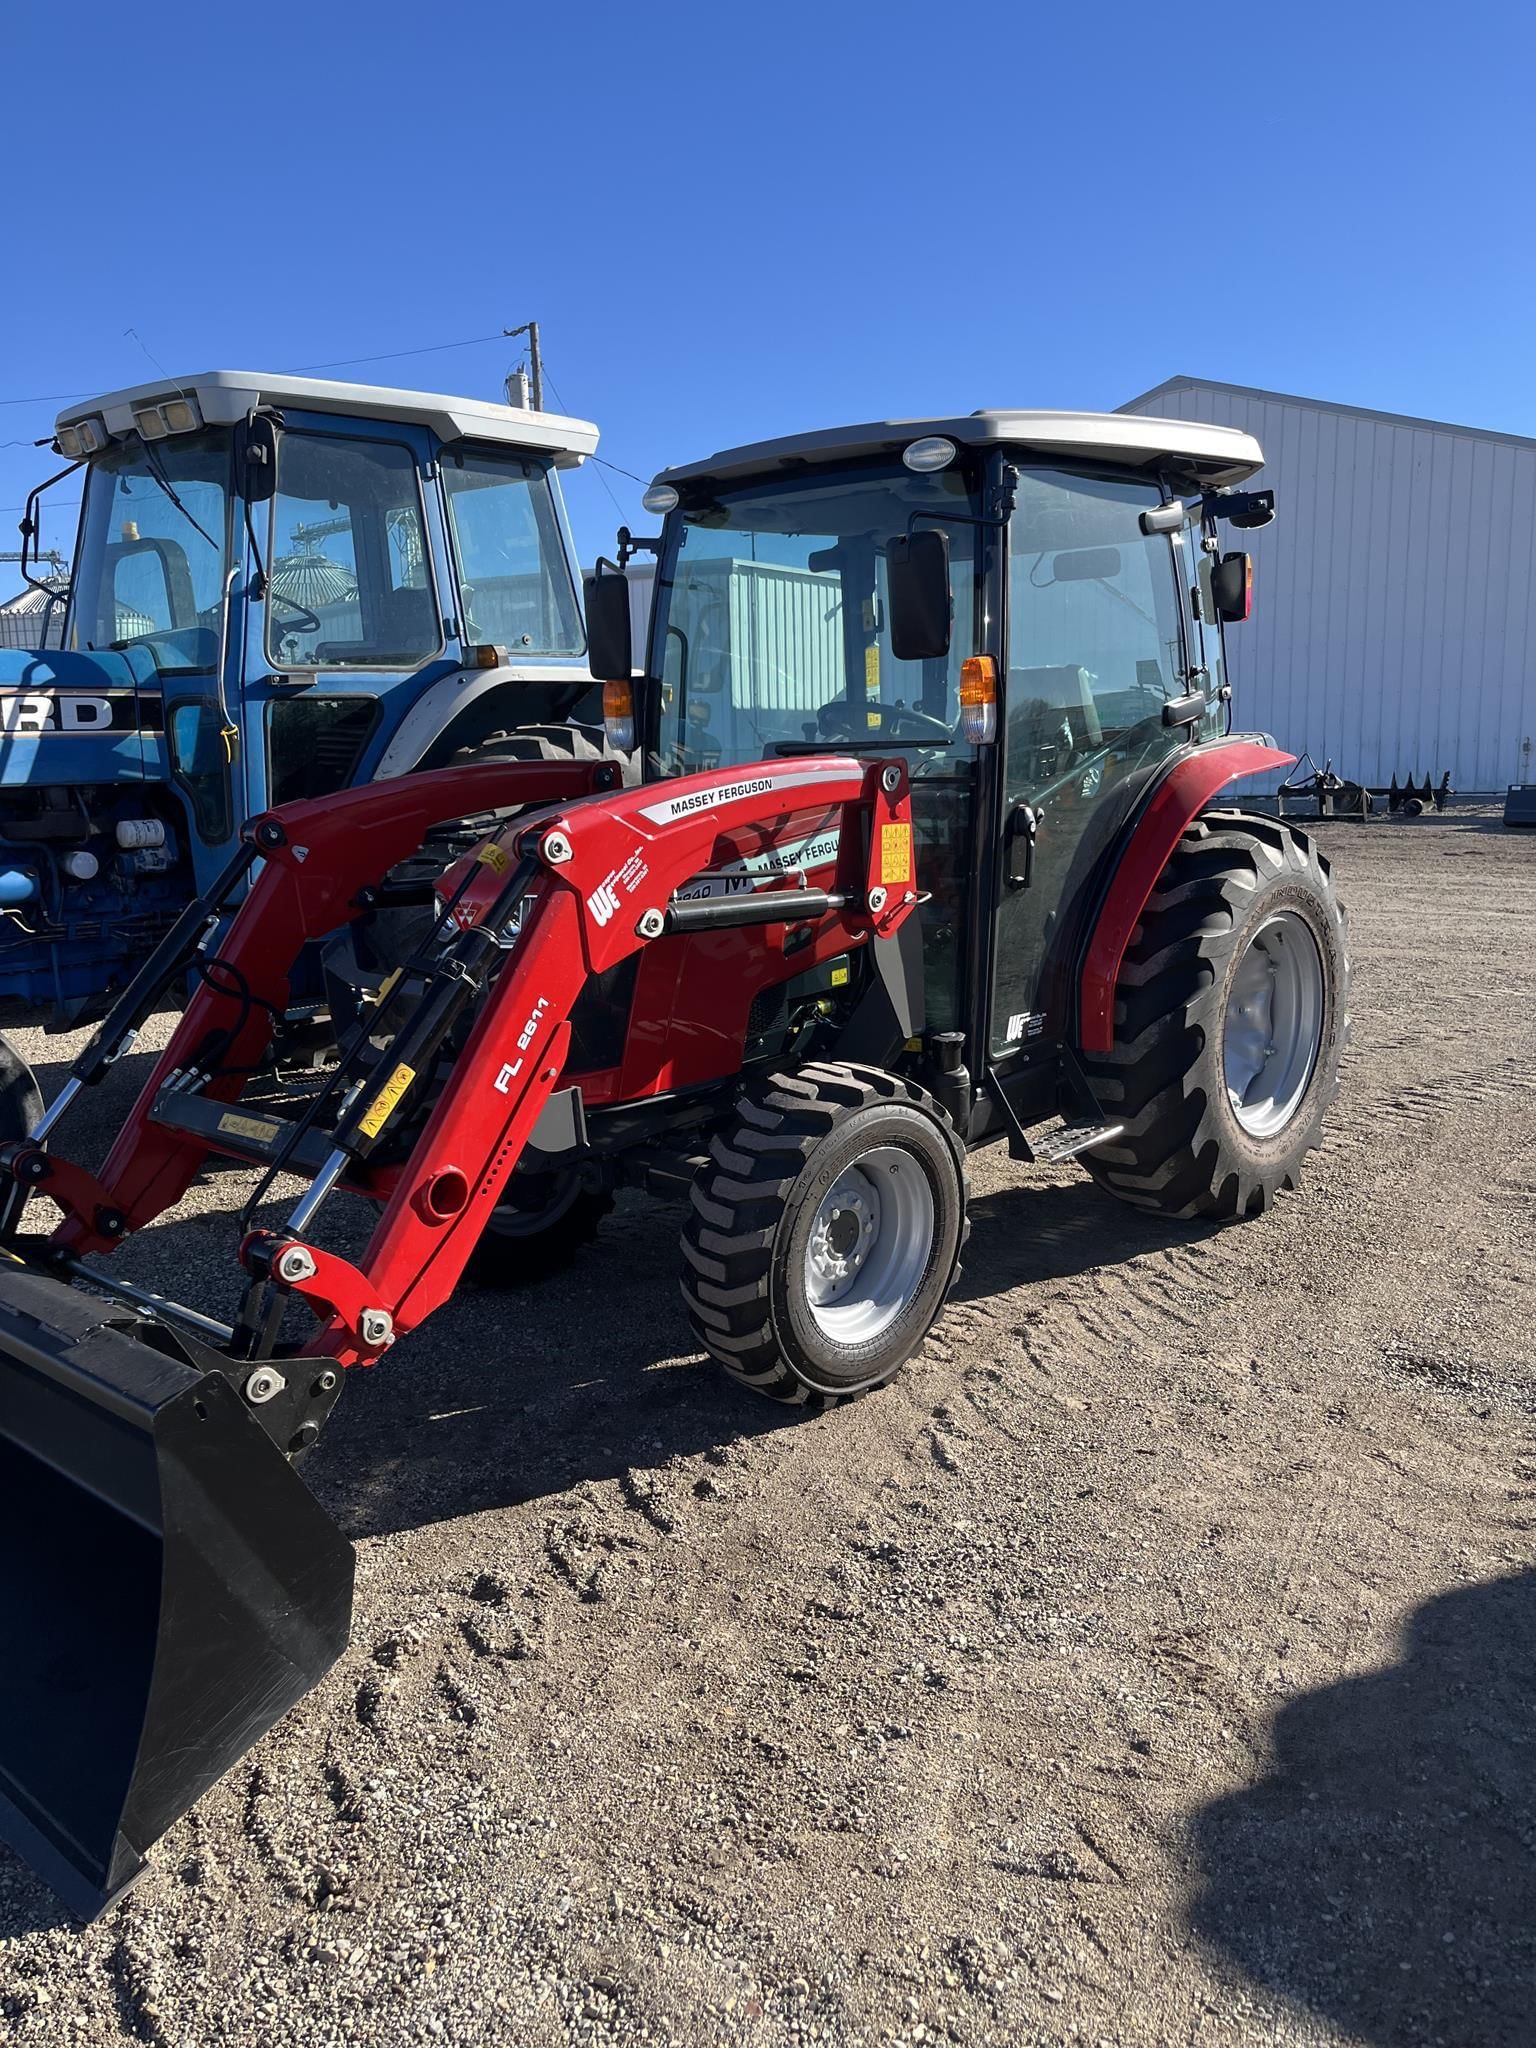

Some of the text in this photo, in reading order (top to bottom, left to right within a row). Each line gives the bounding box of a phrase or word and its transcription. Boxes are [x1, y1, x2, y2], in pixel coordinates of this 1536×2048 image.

[670, 779, 772, 815] MASSEY FERGUSON
[494, 997, 550, 1094] FL 2611
